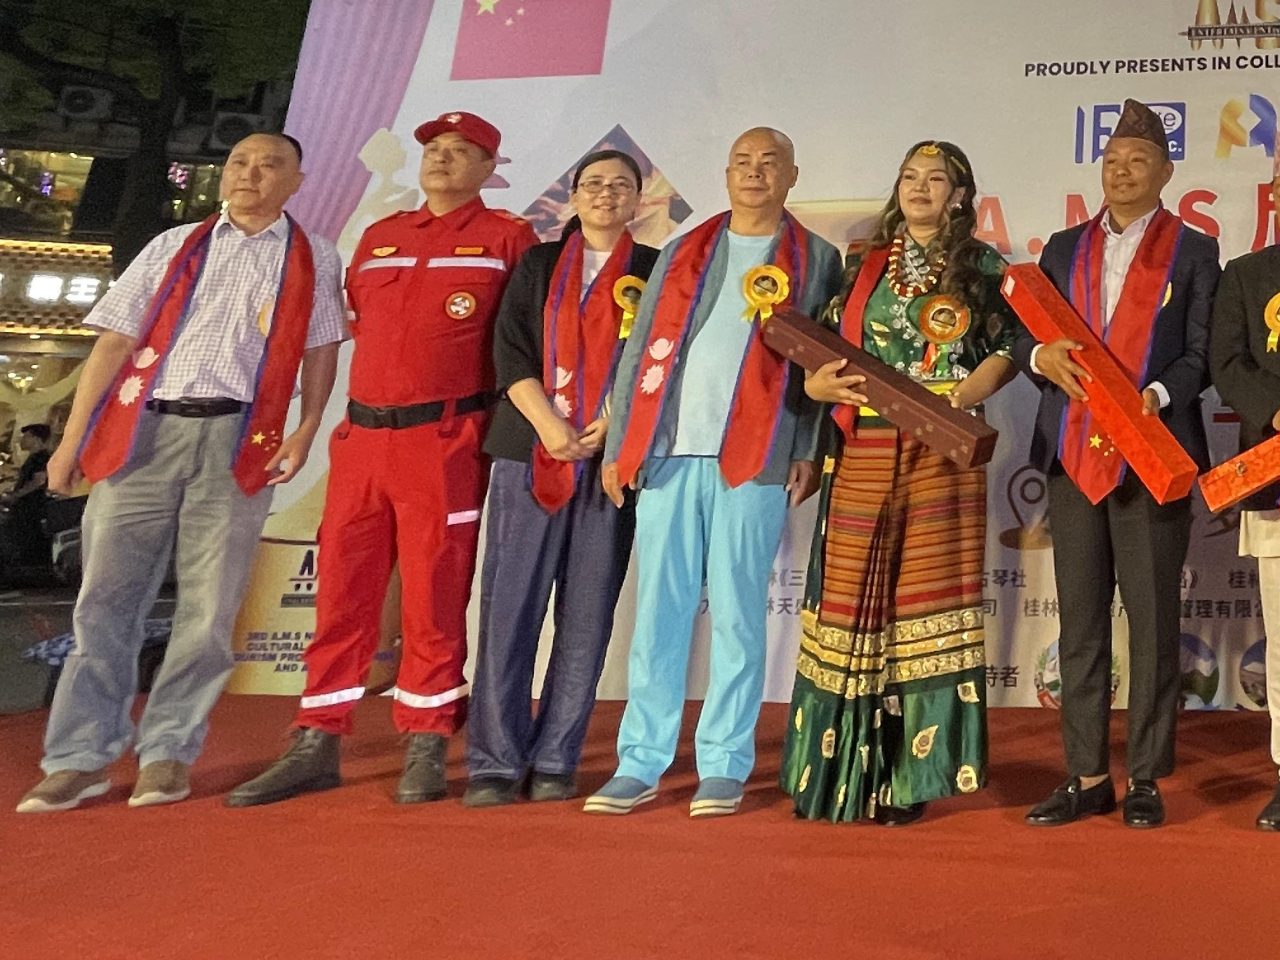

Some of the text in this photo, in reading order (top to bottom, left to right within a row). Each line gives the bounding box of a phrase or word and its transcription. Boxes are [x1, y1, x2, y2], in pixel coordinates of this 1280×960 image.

[1024, 60, 1111, 77] PROUDLY
[1115, 56, 1208, 74] PRESENTS
[1212, 55, 1231, 71] IN
